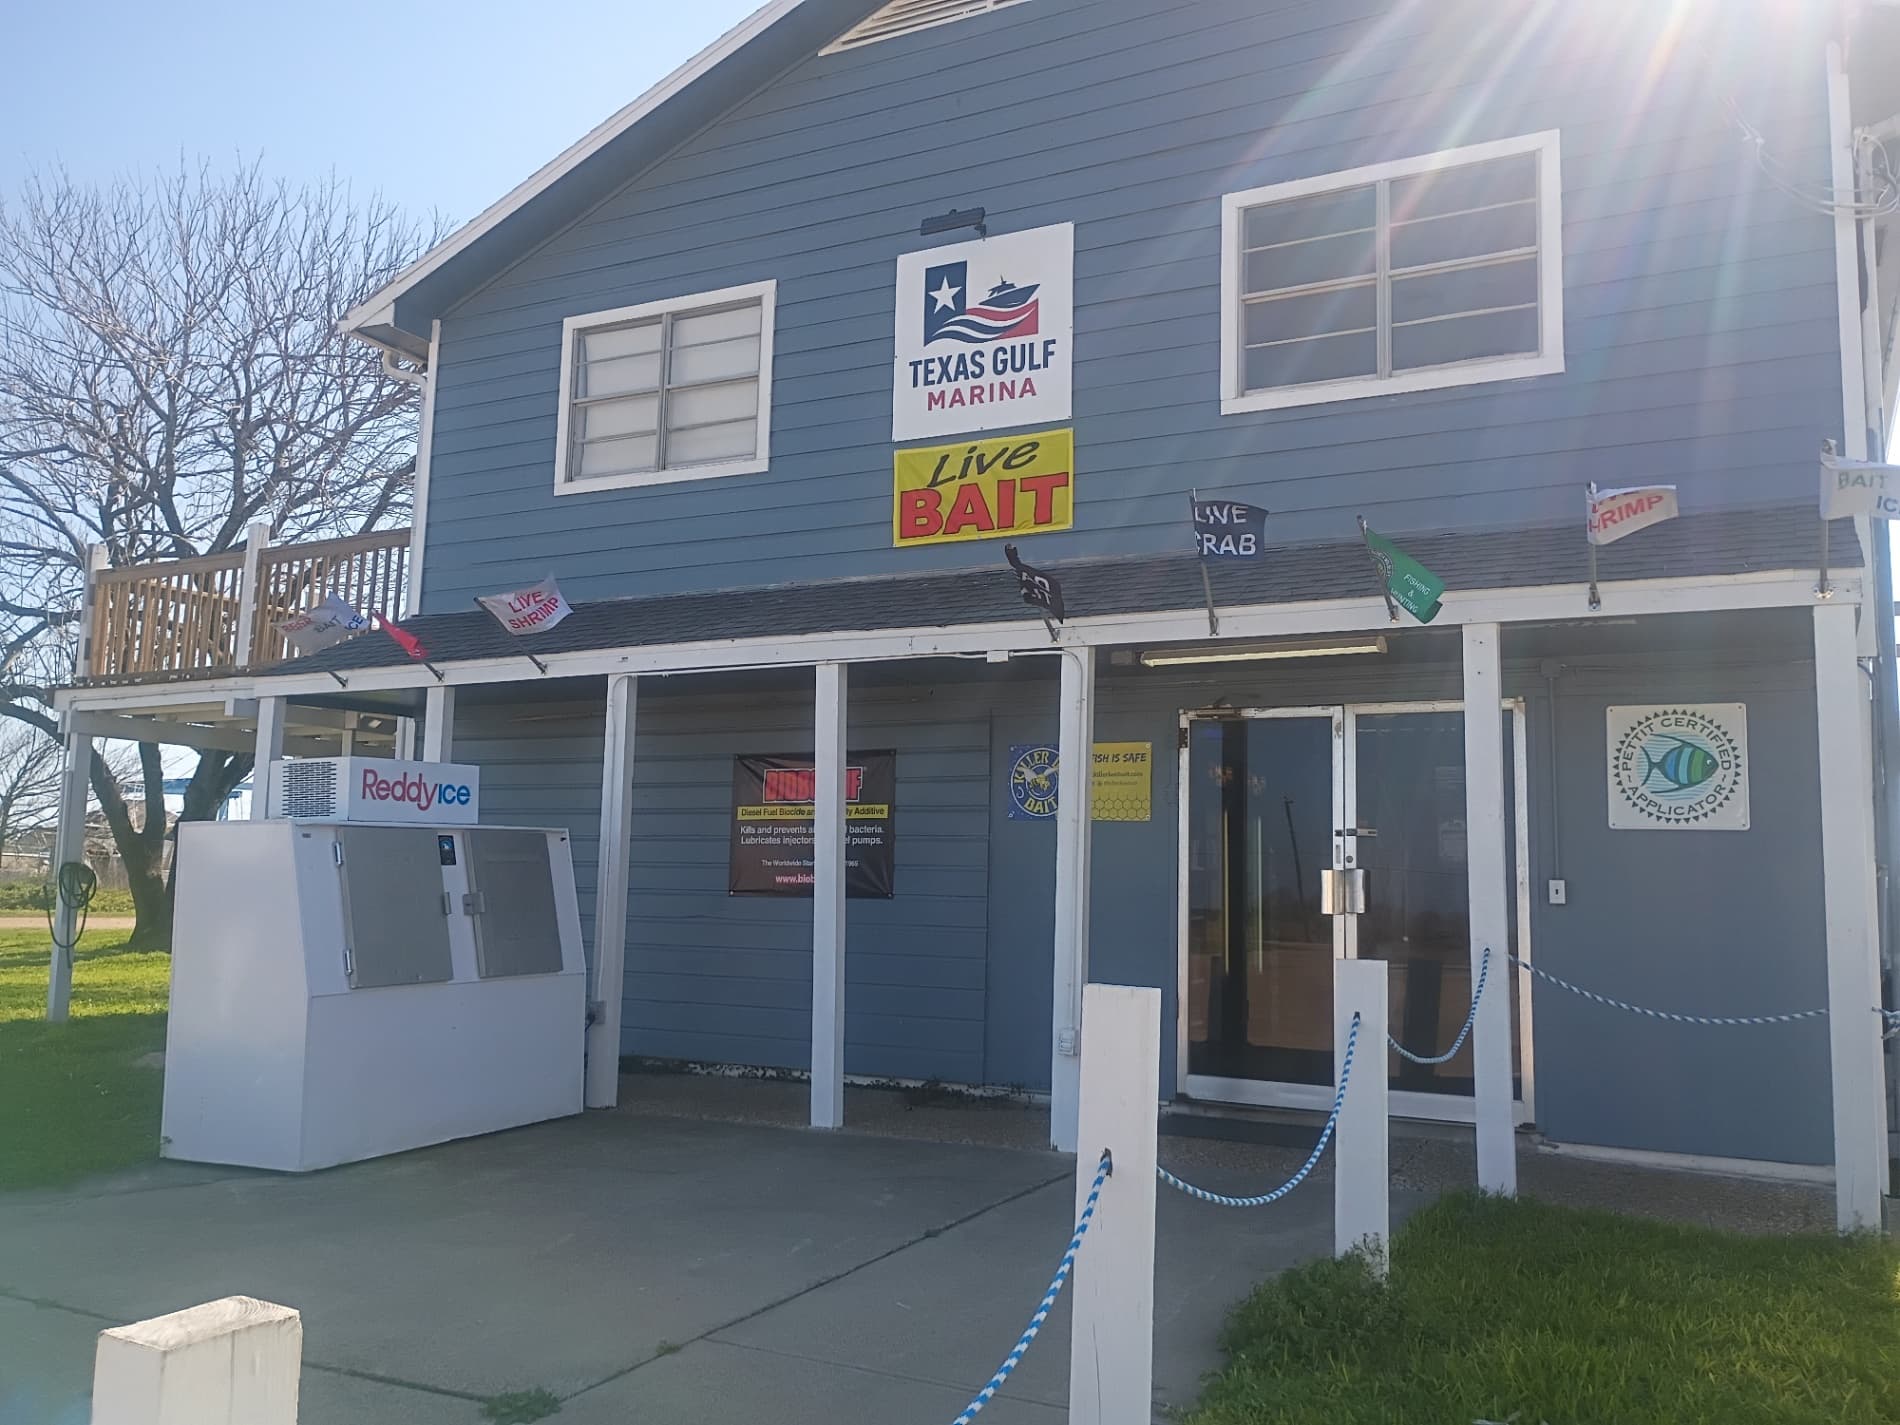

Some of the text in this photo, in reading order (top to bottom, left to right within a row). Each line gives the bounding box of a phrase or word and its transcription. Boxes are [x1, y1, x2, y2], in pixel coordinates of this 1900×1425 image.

[909, 339, 1056, 388] TEXAS GULF
[927, 377, 1037, 411] MARINA
[926, 441, 1040, 489] Live
[1838, 472, 1888, 490] BAIT
[900, 471, 1069, 539] BAIT
[1195, 504, 1248, 524] LIVE
[1588, 495, 1664, 533] HRIMP
[1876, 495, 1900, 514] IC
[1403, 573, 1430, 596] FISHING
[508, 591, 545, 613] LIVE
[508, 597, 559, 629] SHRIMP
[1622, 717, 1731, 772] PETTIT CERTIFIED
[1112, 753, 1120, 762] IS
[1123, 752, 1147, 762] SAFE
[763, 808, 778, 816] Fuel
[779, 807, 806, 816] Biocide
[854, 806, 885, 815] Additive
[1023, 798, 1058, 813] BAIT
[1628, 784, 1727, 816] APPLICATOR
[740, 835, 781, 845] Lubricates
[852, 836, 883, 846] pumps.
[757, 826, 772, 834] and
[773, 826, 806, 836] prevents
